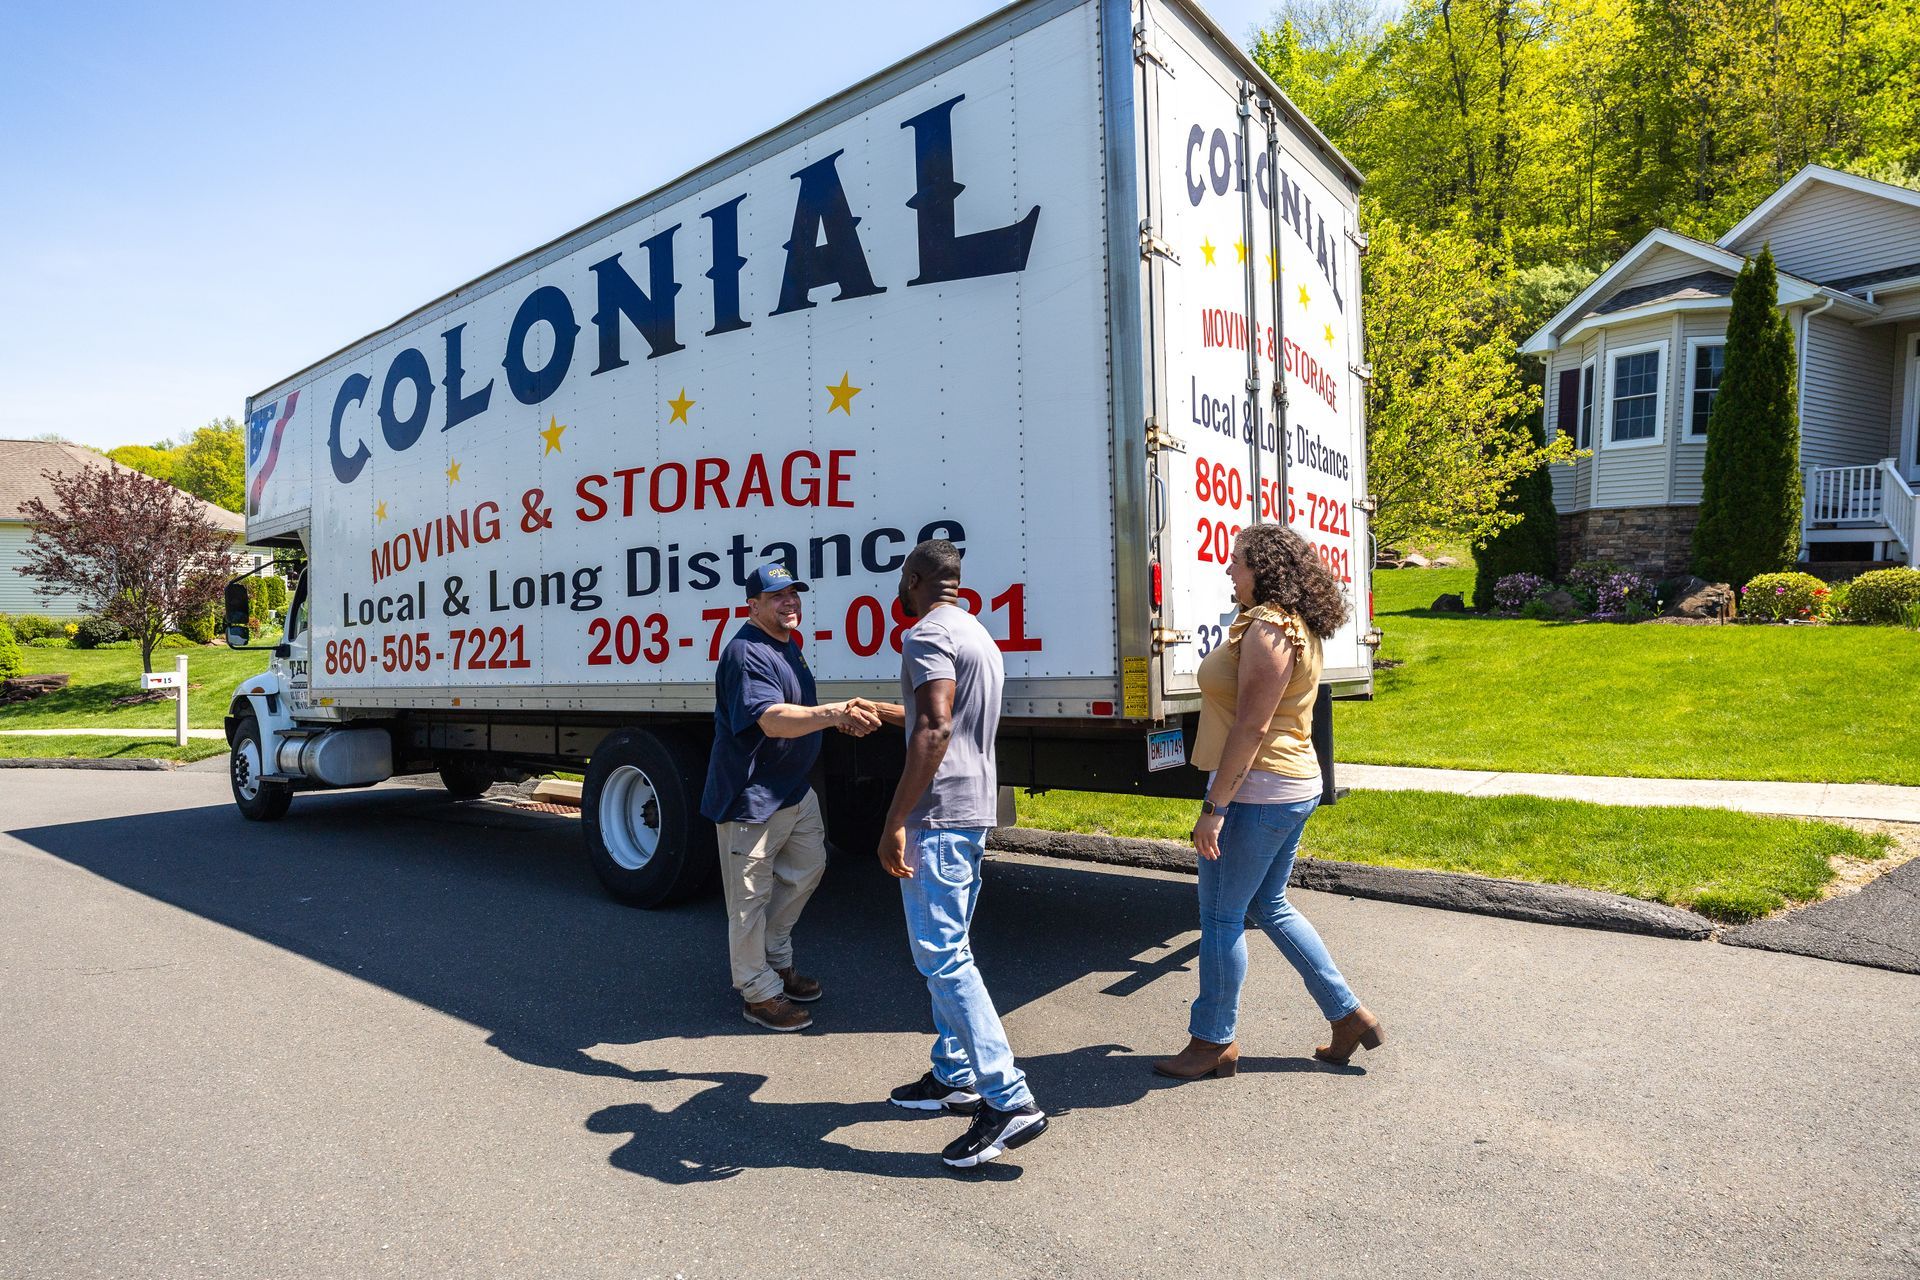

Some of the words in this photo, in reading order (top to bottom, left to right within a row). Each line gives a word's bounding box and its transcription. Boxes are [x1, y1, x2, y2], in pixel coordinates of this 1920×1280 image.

[327, 93, 1042, 485] COLONIAL
[1283, 336, 1338, 414] STORAGE
[1192, 375, 1236, 439] Local
[1242, 400, 1254, 447] &
[1260, 407, 1293, 468] Log
[1297, 424, 1349, 482] Distance
[371, 500, 501, 585] MOVING
[520, 488, 553, 533] &
[575, 449, 858, 523] STORAGE
[325, 624, 531, 676] 860-505-7221
[587, 583, 1043, 666] 203-7-01
[343, 580, 426, 628] Local
[442, 575, 470, 617] &
[489, 565, 603, 612] Long
